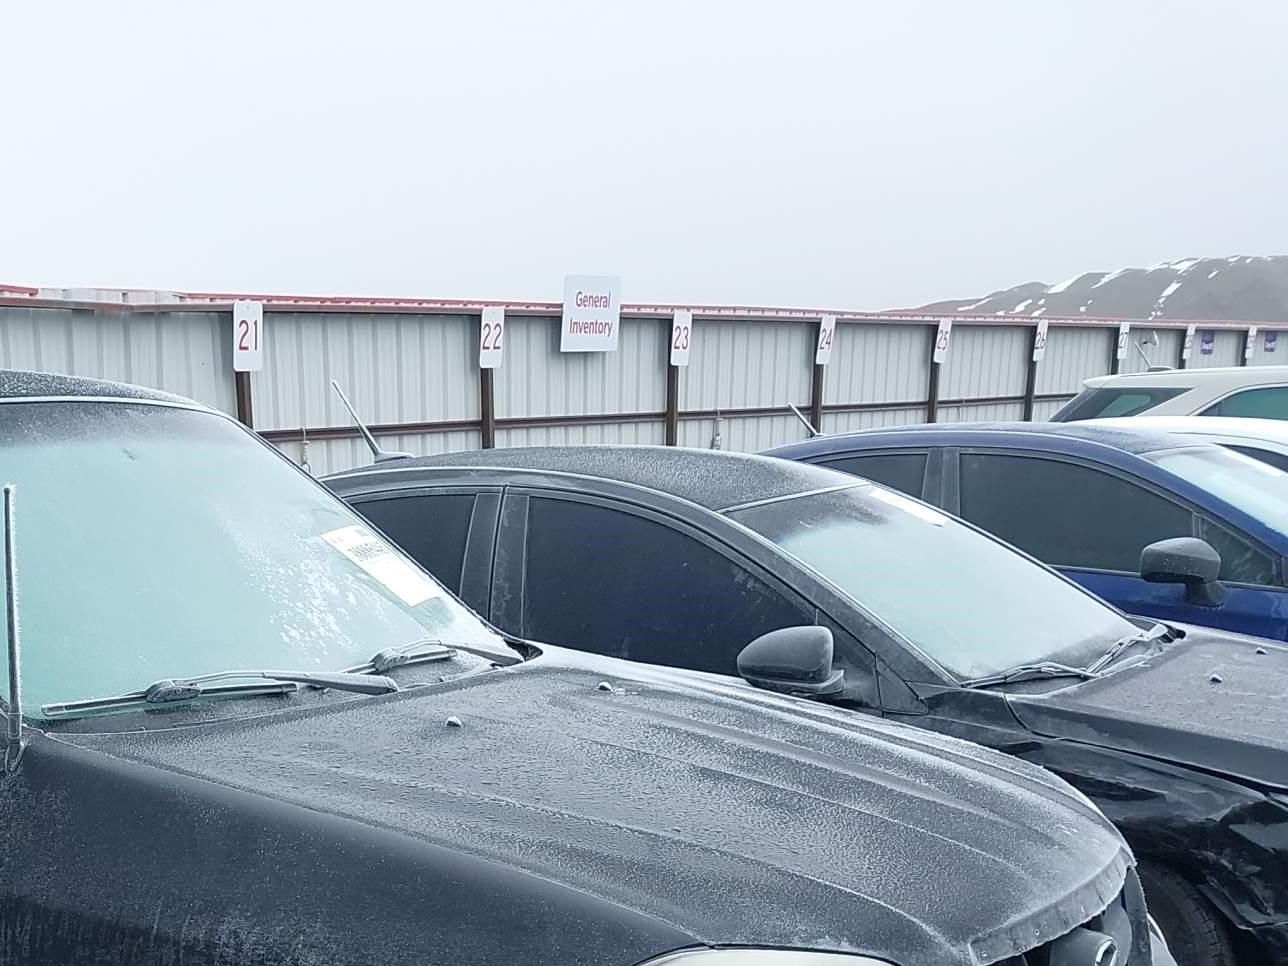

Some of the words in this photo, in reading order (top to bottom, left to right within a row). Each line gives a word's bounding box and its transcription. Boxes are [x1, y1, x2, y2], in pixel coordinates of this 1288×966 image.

[575, 291, 611, 309] General
[238, 319, 258, 351] 21
[482, 322, 502, 350] 22
[569, 316, 613, 337] Inventory
[673, 325, 689, 350] 23
[818, 327, 833, 350] 24
[936, 329, 949, 351] 25
